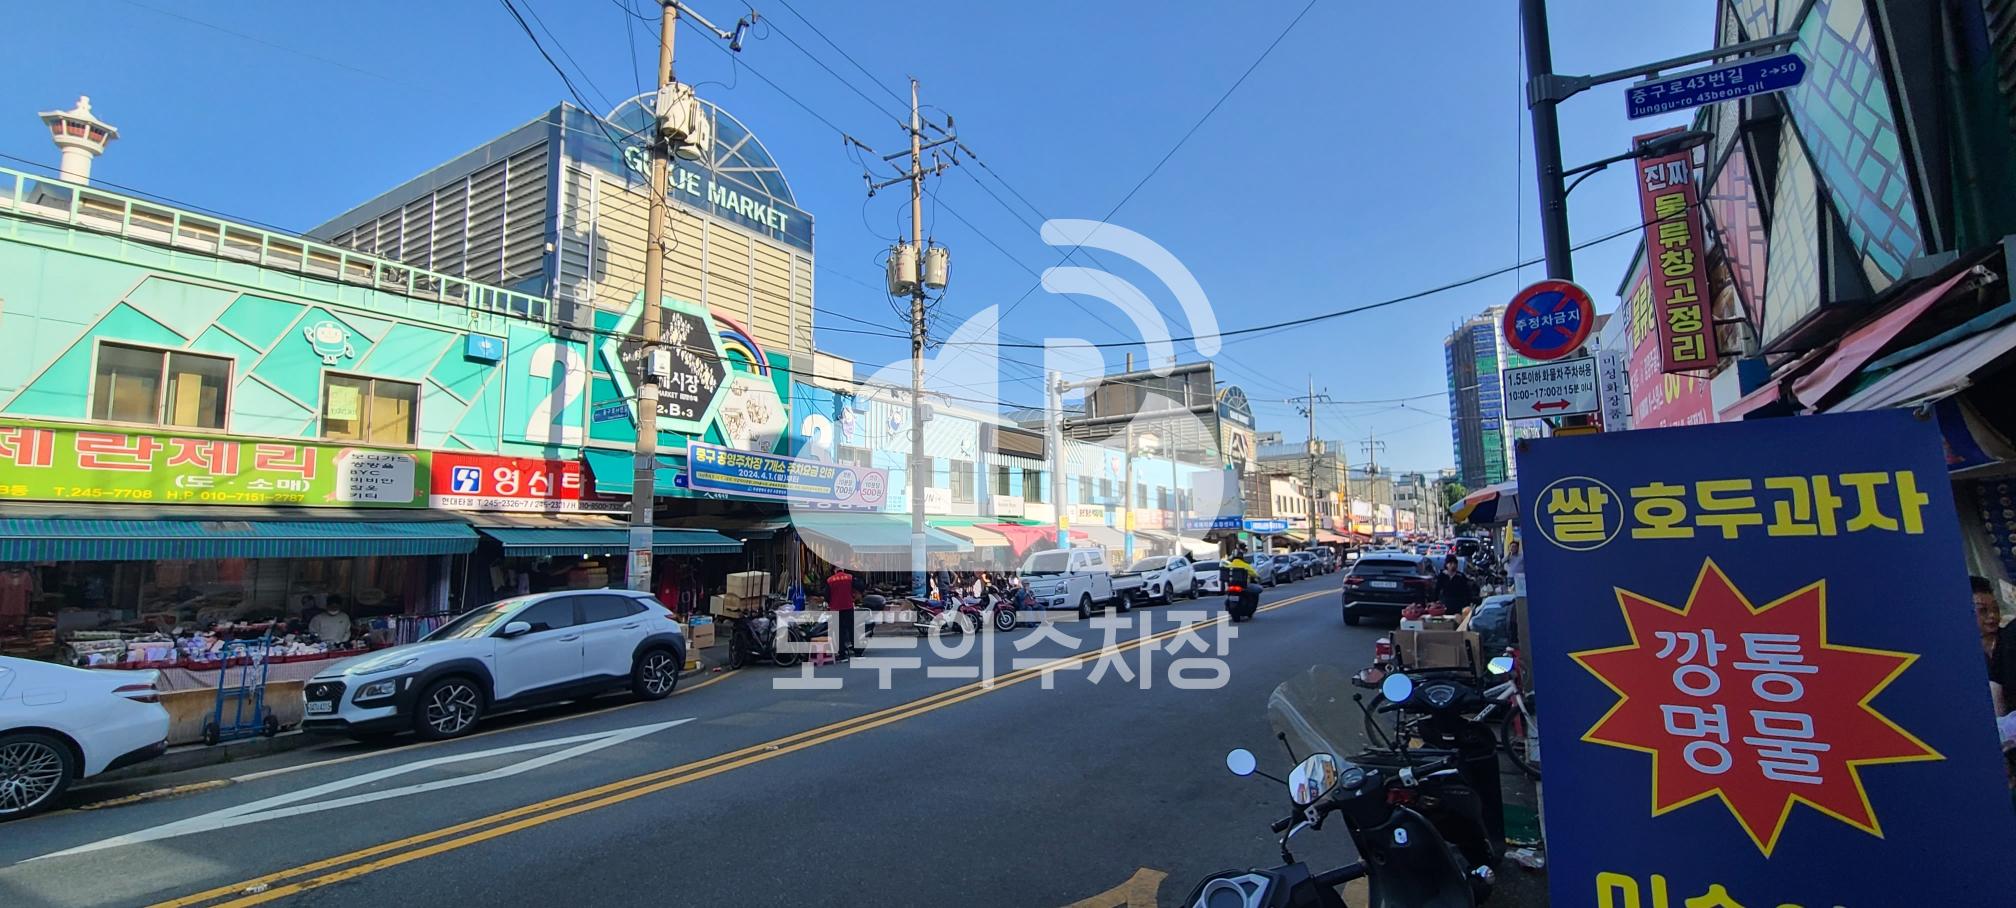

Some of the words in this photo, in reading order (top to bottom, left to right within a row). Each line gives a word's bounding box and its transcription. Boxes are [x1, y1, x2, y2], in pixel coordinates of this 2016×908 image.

[1632, 67, 1744, 104] 중구로43번길
[1632, 96, 1693, 116] Junggu-ro
[1696, 81, 1765, 104] 43beon-gil
[1644, 159, 1689, 192] 진짜
[708, 181, 788, 233] MARKET
[1515, 308, 1580, 333] 주정차금지
[695, 447, 716, 464] 중구
[1547, 486, 1608, 543] 쌀
[1629, 470, 1930, 540] 호두과자
[1654, 629, 1819, 702] 깡통
[1659, 704, 1831, 785] 명물
